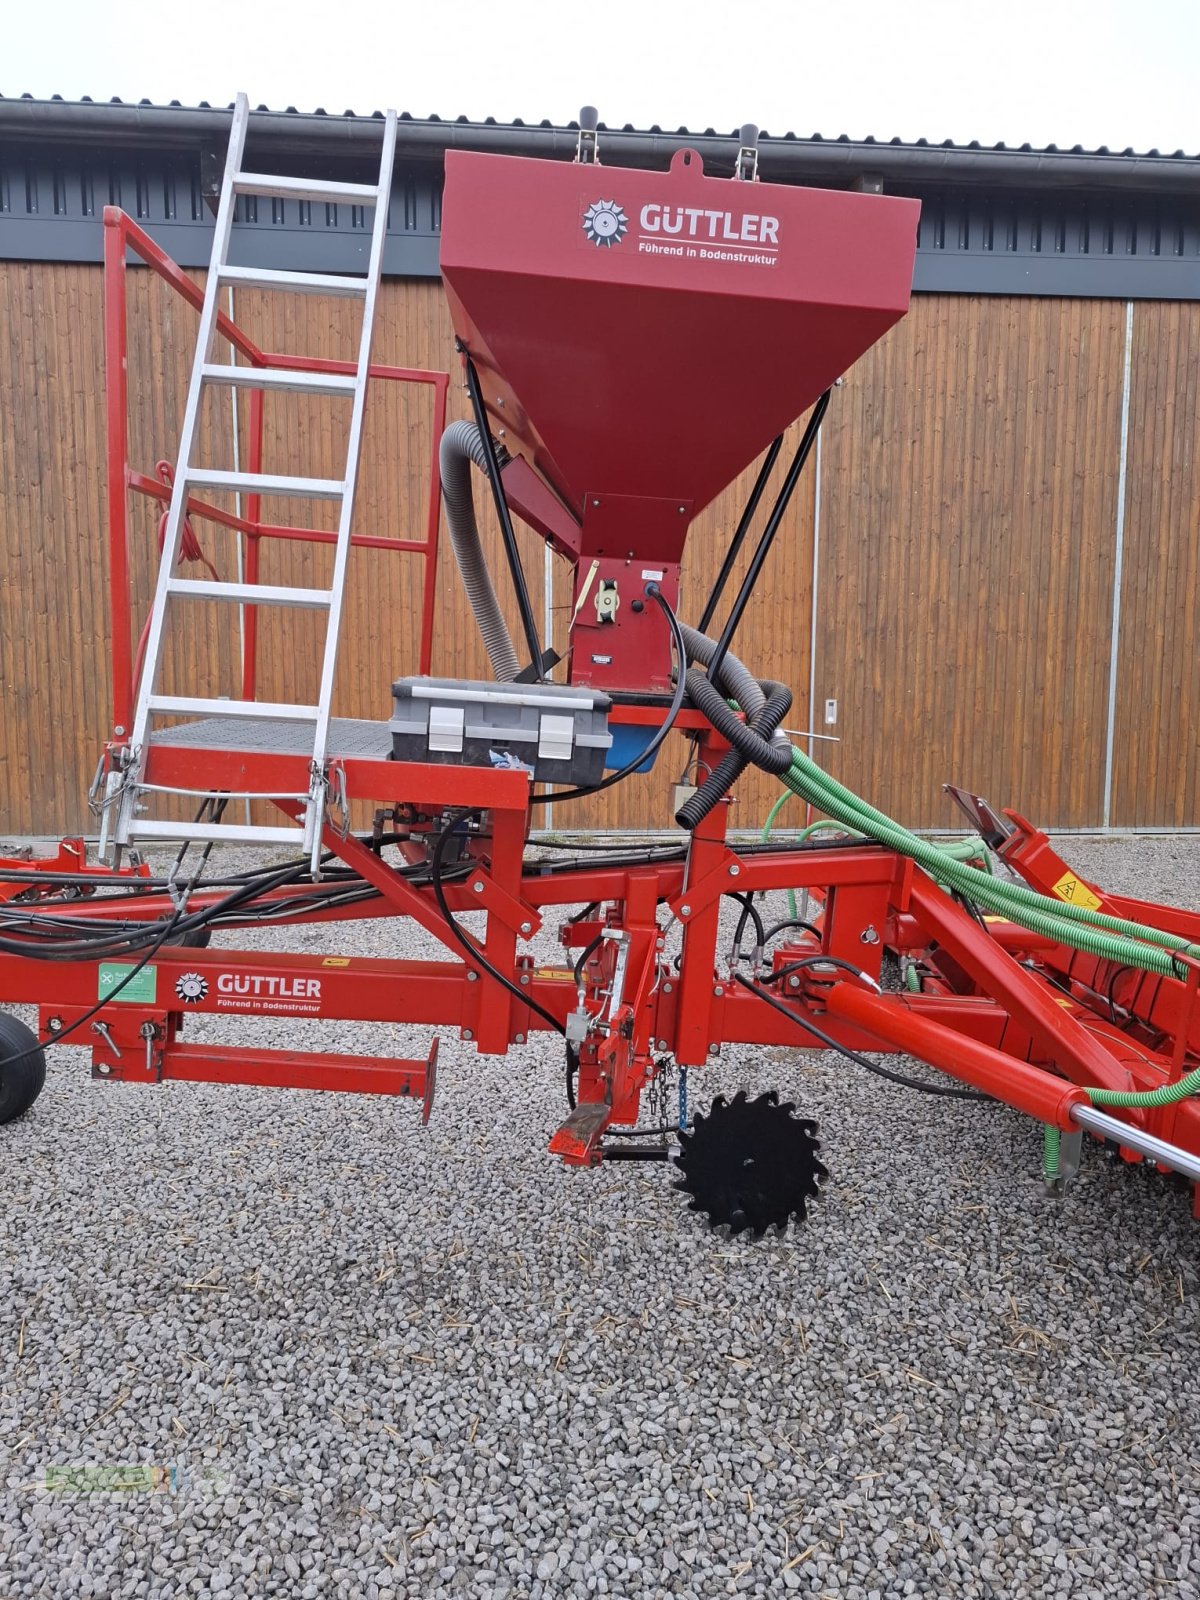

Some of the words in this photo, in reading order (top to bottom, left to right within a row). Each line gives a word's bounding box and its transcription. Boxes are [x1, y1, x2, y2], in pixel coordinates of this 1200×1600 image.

[640, 204, 779, 243] GÜTTLER
[639, 243, 683, 256] Führend
[687, 247, 697, 257] in
[700, 250, 777, 265] Bodenstruktur
[217, 974, 321, 997] GÜTTLER
[217, 999, 251, 1008] Führend
[253, 1001, 261, 1009] in
[262, 1002, 321, 1012] Bodenstruktur
